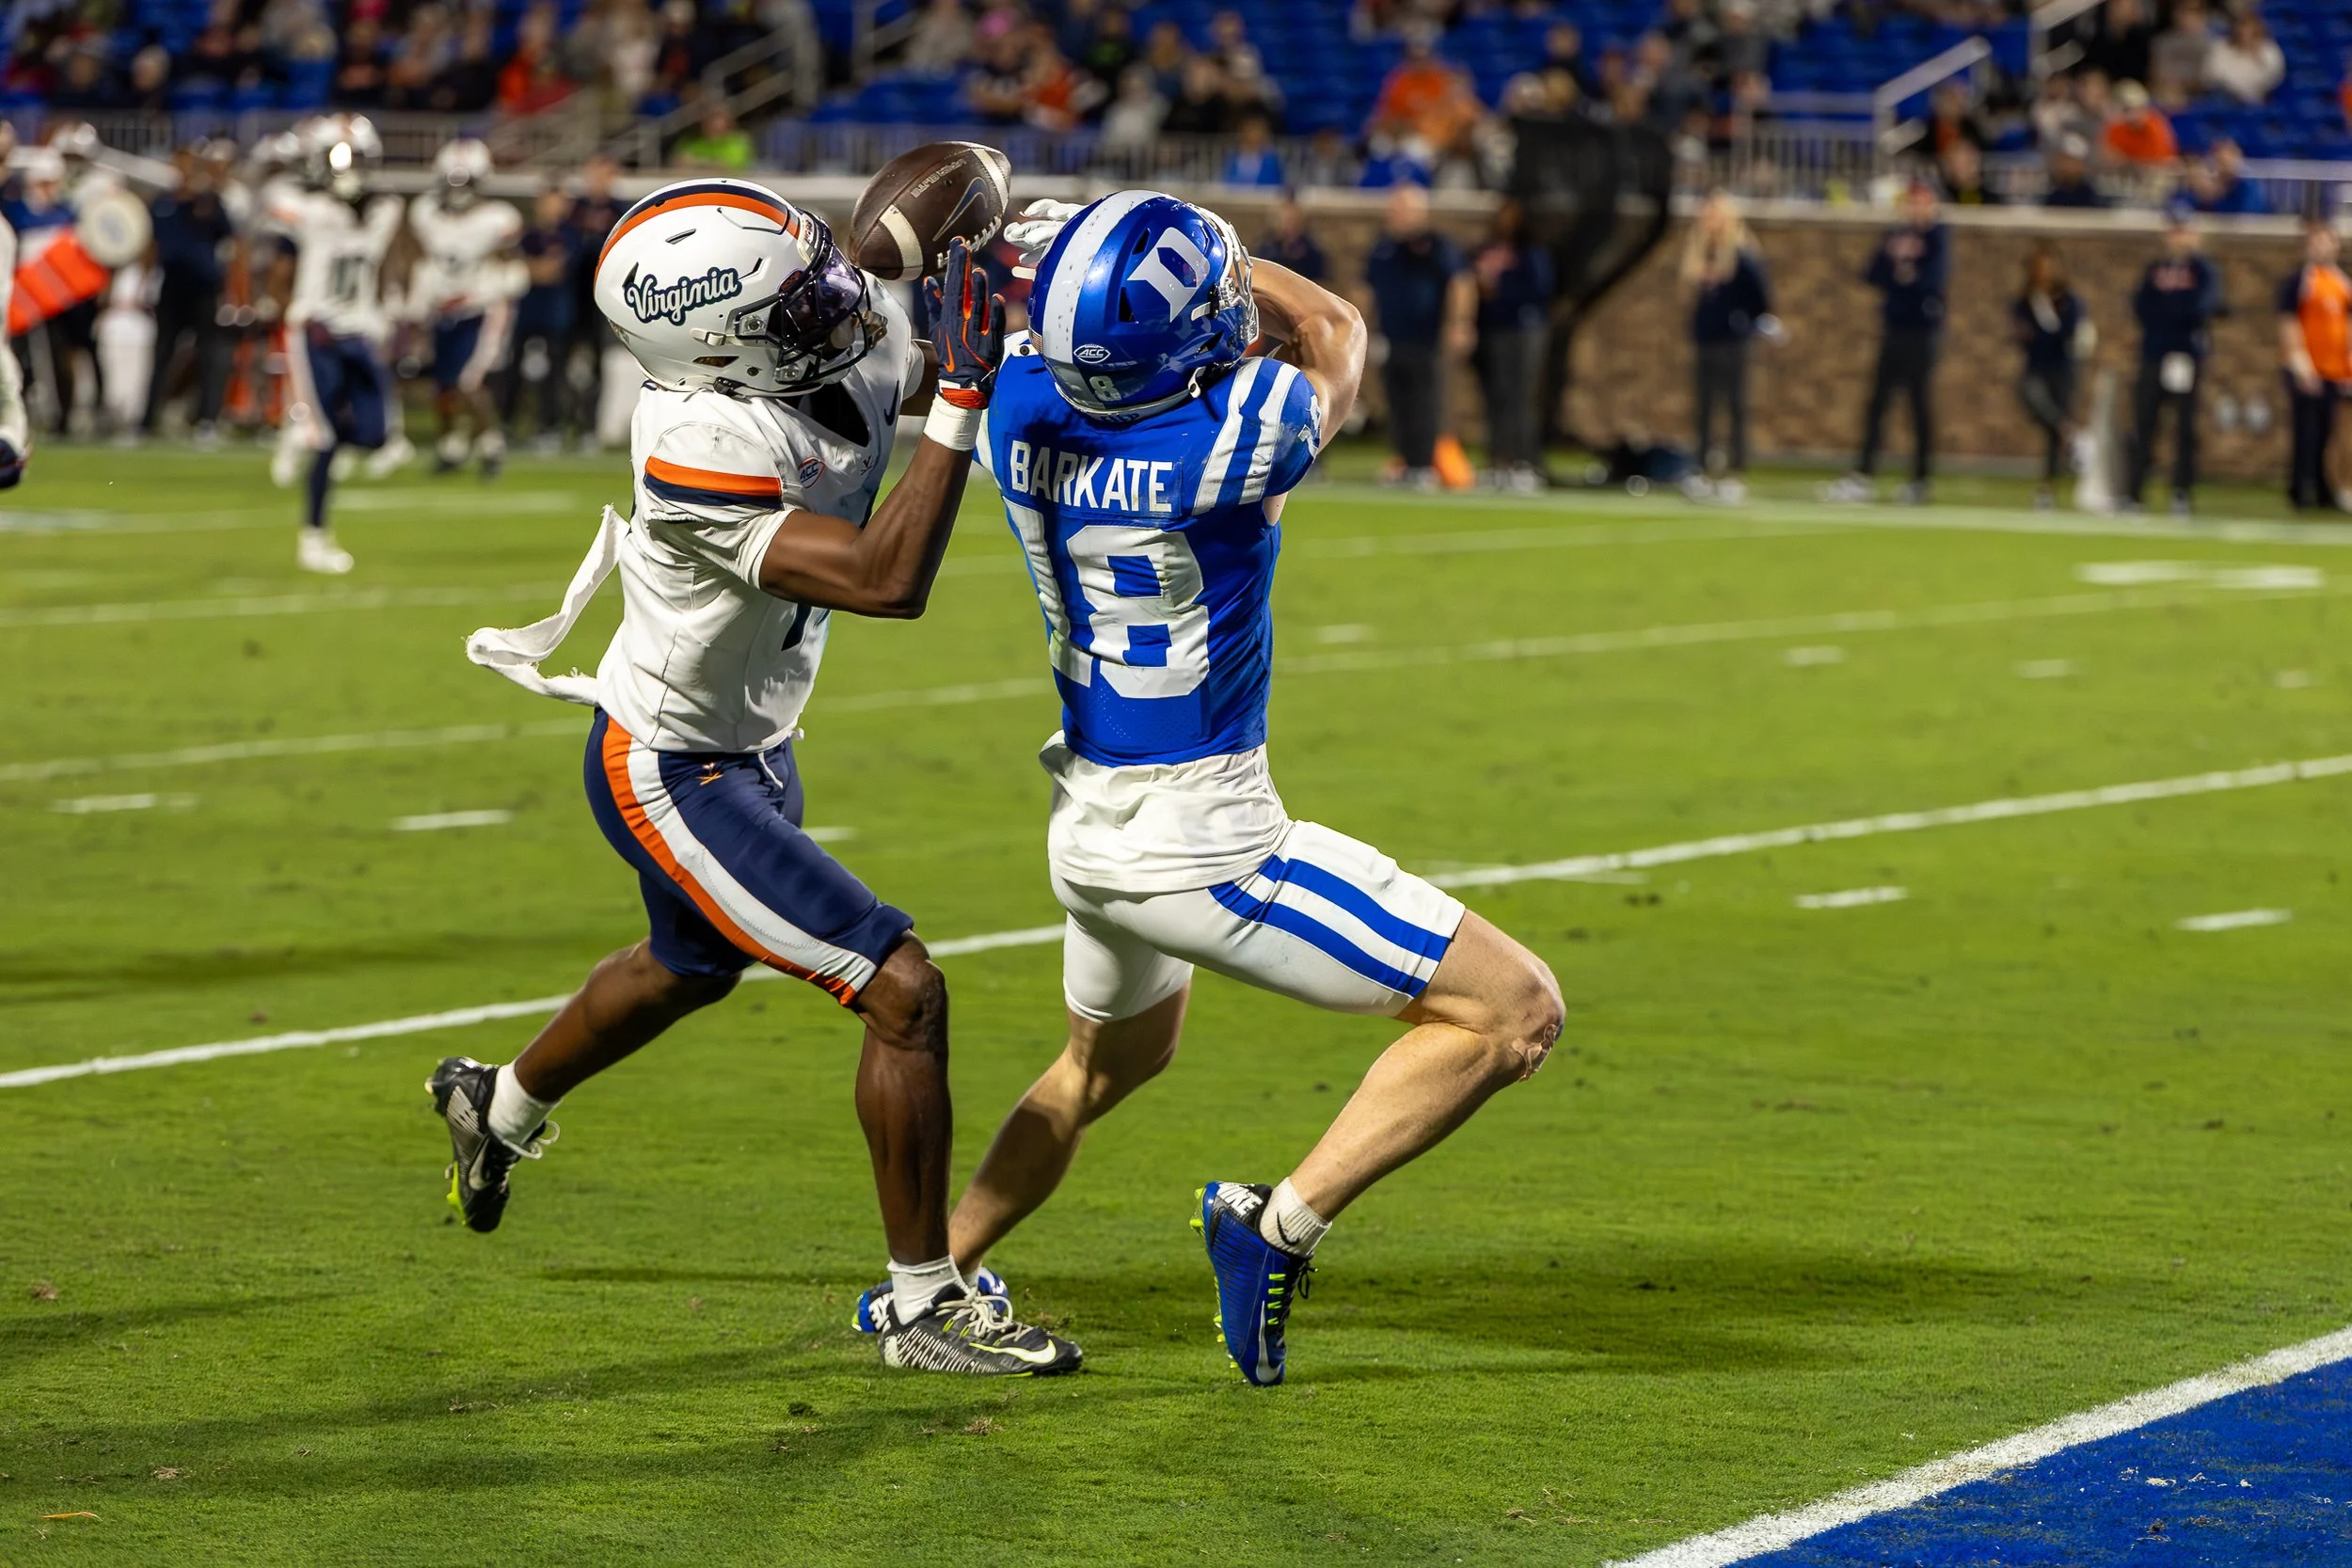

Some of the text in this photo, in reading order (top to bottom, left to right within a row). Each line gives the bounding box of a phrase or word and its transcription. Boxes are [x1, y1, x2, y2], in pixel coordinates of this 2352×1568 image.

[625, 267, 742, 326] Virginia
[1126, 227, 1211, 323] D
[1009, 439, 1173, 513] BARKATE
[1002, 496, 1211, 699] 18
